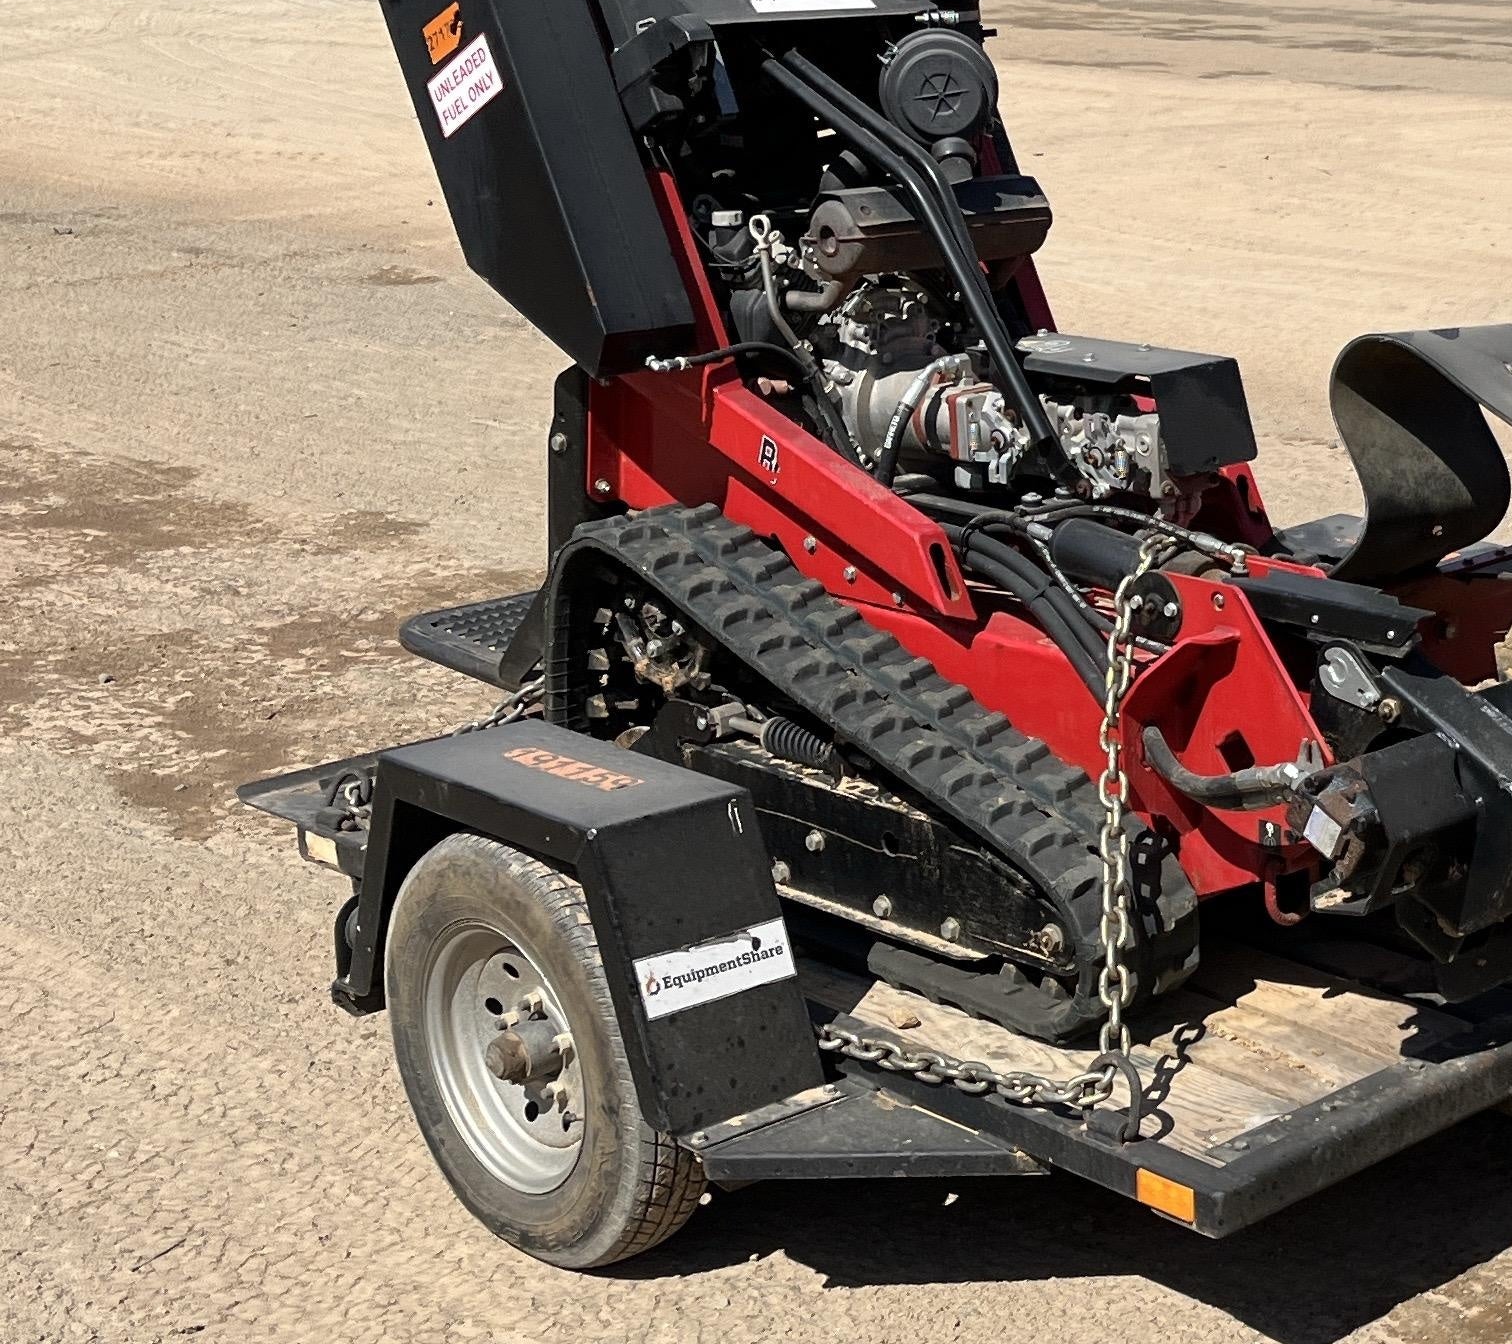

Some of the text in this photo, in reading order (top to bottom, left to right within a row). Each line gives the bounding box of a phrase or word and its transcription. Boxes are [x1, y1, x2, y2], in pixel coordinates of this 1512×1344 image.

[433, 47, 487, 103] UNLEADED
[441, 69, 495, 127] FUEL ONLY
[662, 944, 784, 989] EquipmentShare
